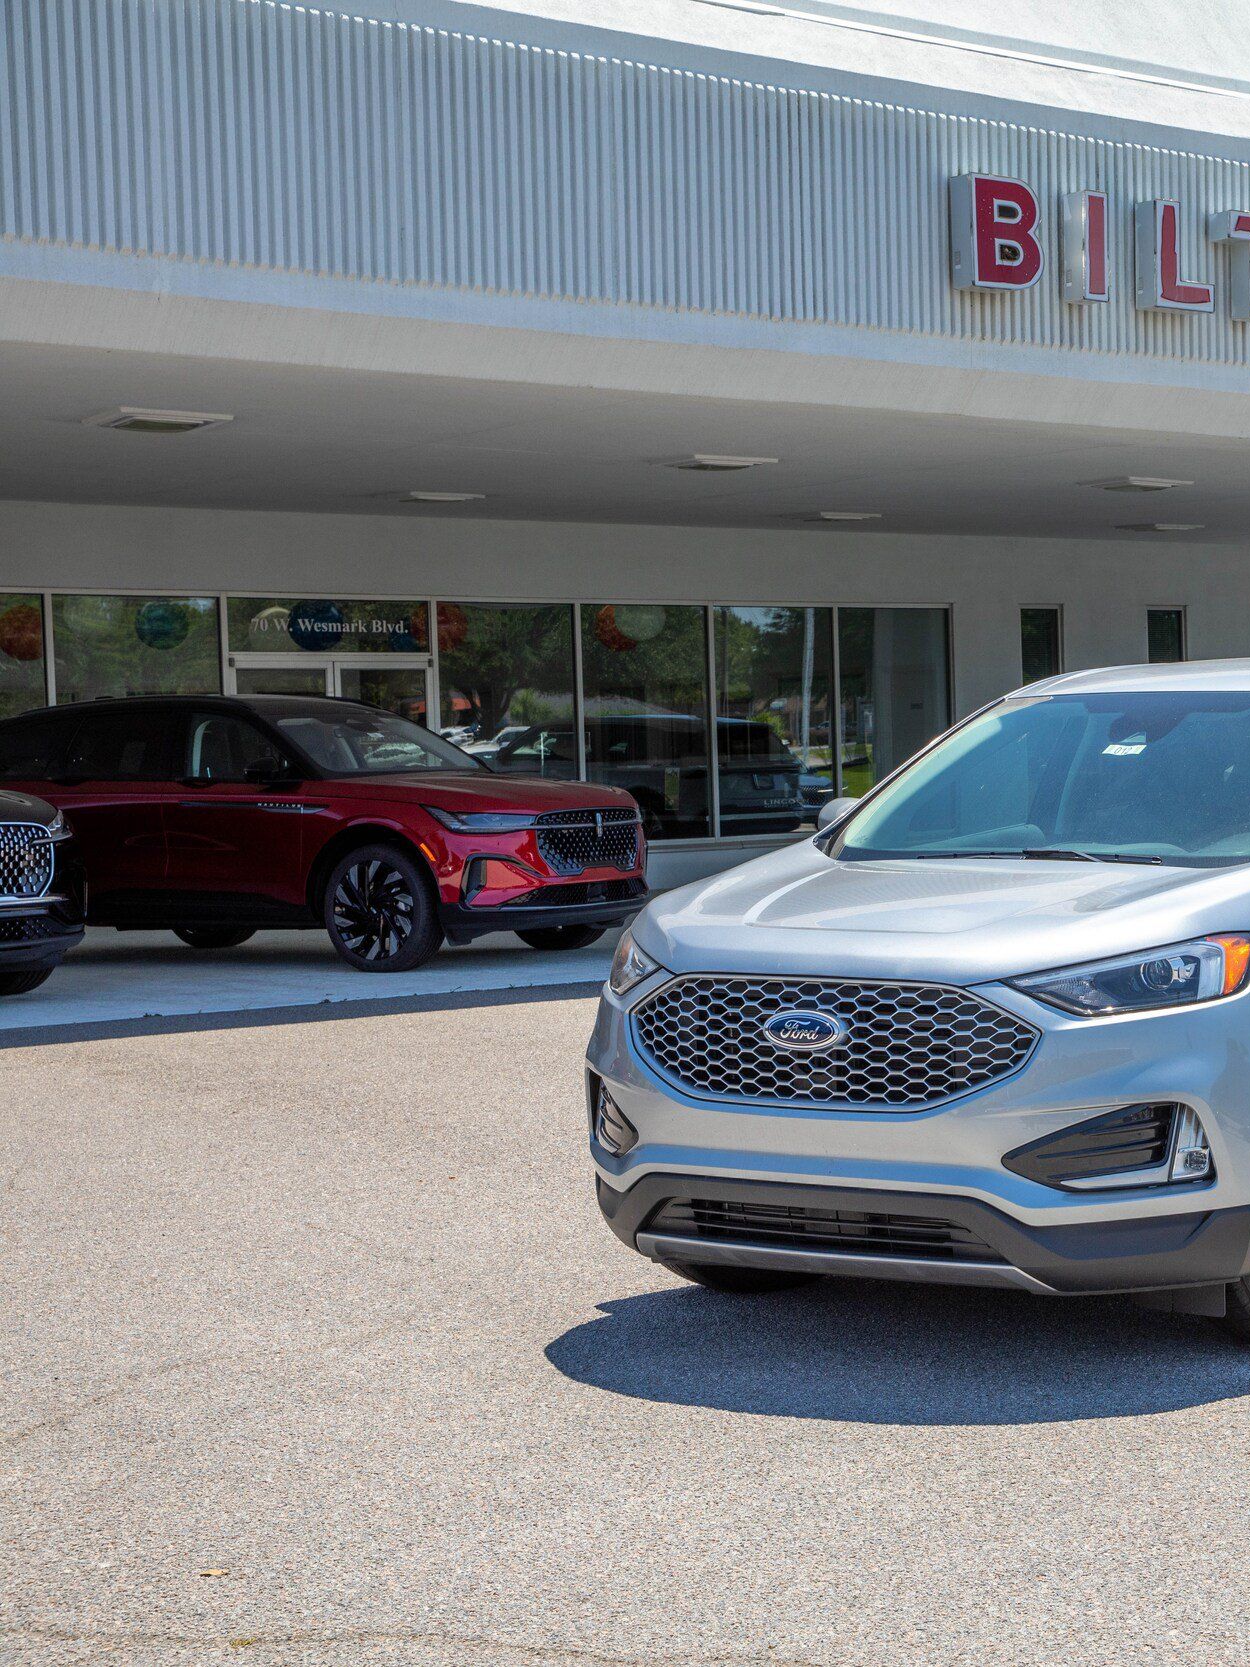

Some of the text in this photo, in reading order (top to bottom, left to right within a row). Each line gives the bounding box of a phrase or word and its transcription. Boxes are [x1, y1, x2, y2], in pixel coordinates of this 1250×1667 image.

[251, 618, 409, 634] 70 W. Wesmark Blvd.
[780, 1019, 820, 1040] Ford
